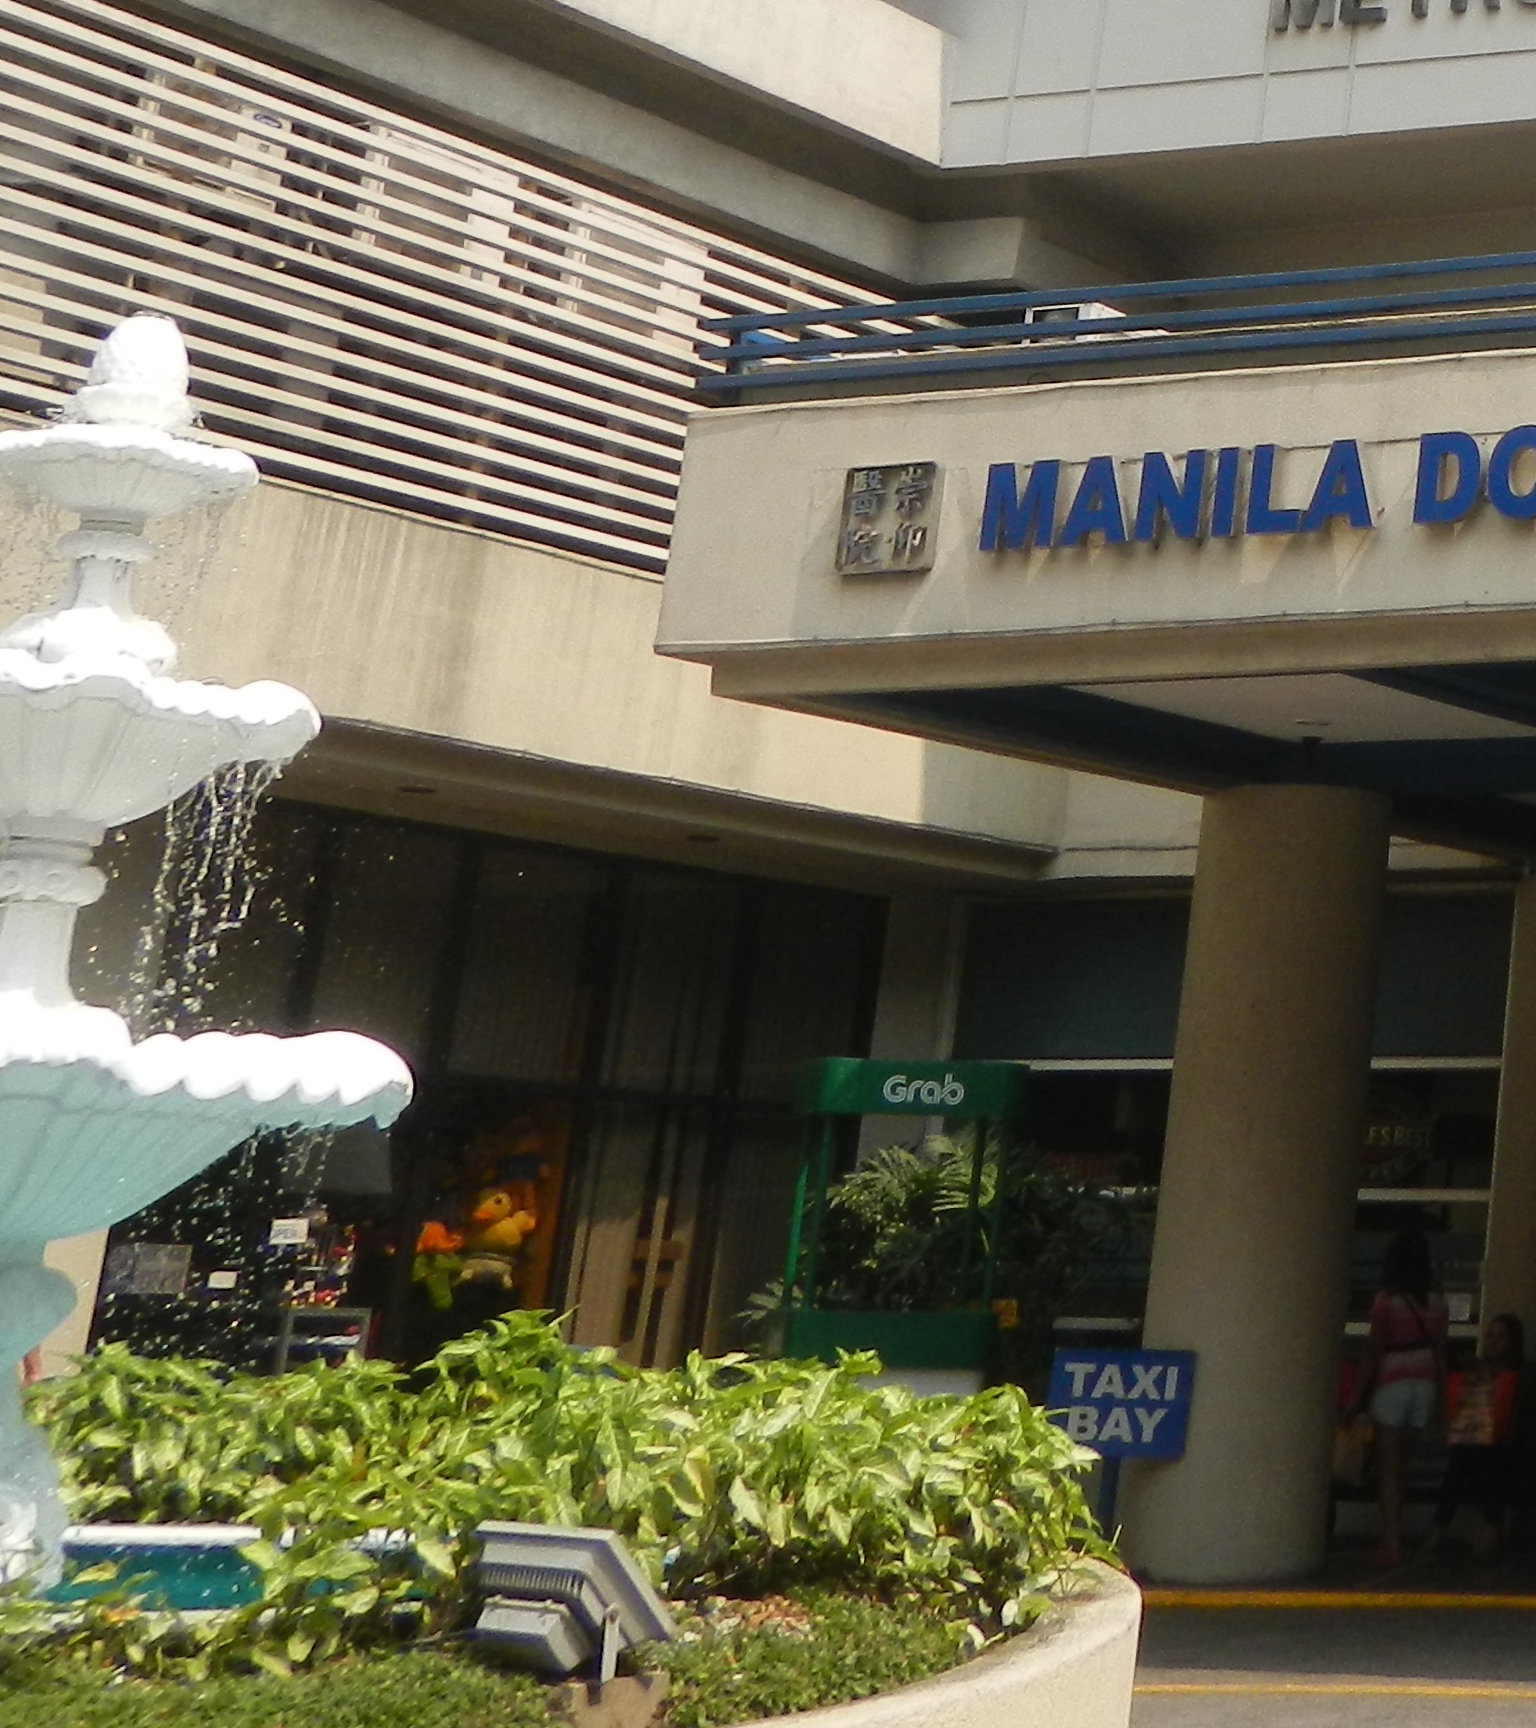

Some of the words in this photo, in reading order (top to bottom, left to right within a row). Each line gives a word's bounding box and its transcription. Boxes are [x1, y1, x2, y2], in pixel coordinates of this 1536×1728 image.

[979, 438, 1374, 552] MANILA
[883, 1073, 965, 1106] Grab
[1064, 1362, 1179, 1401] TAXI
[1067, 1405, 1168, 1443] BAY
